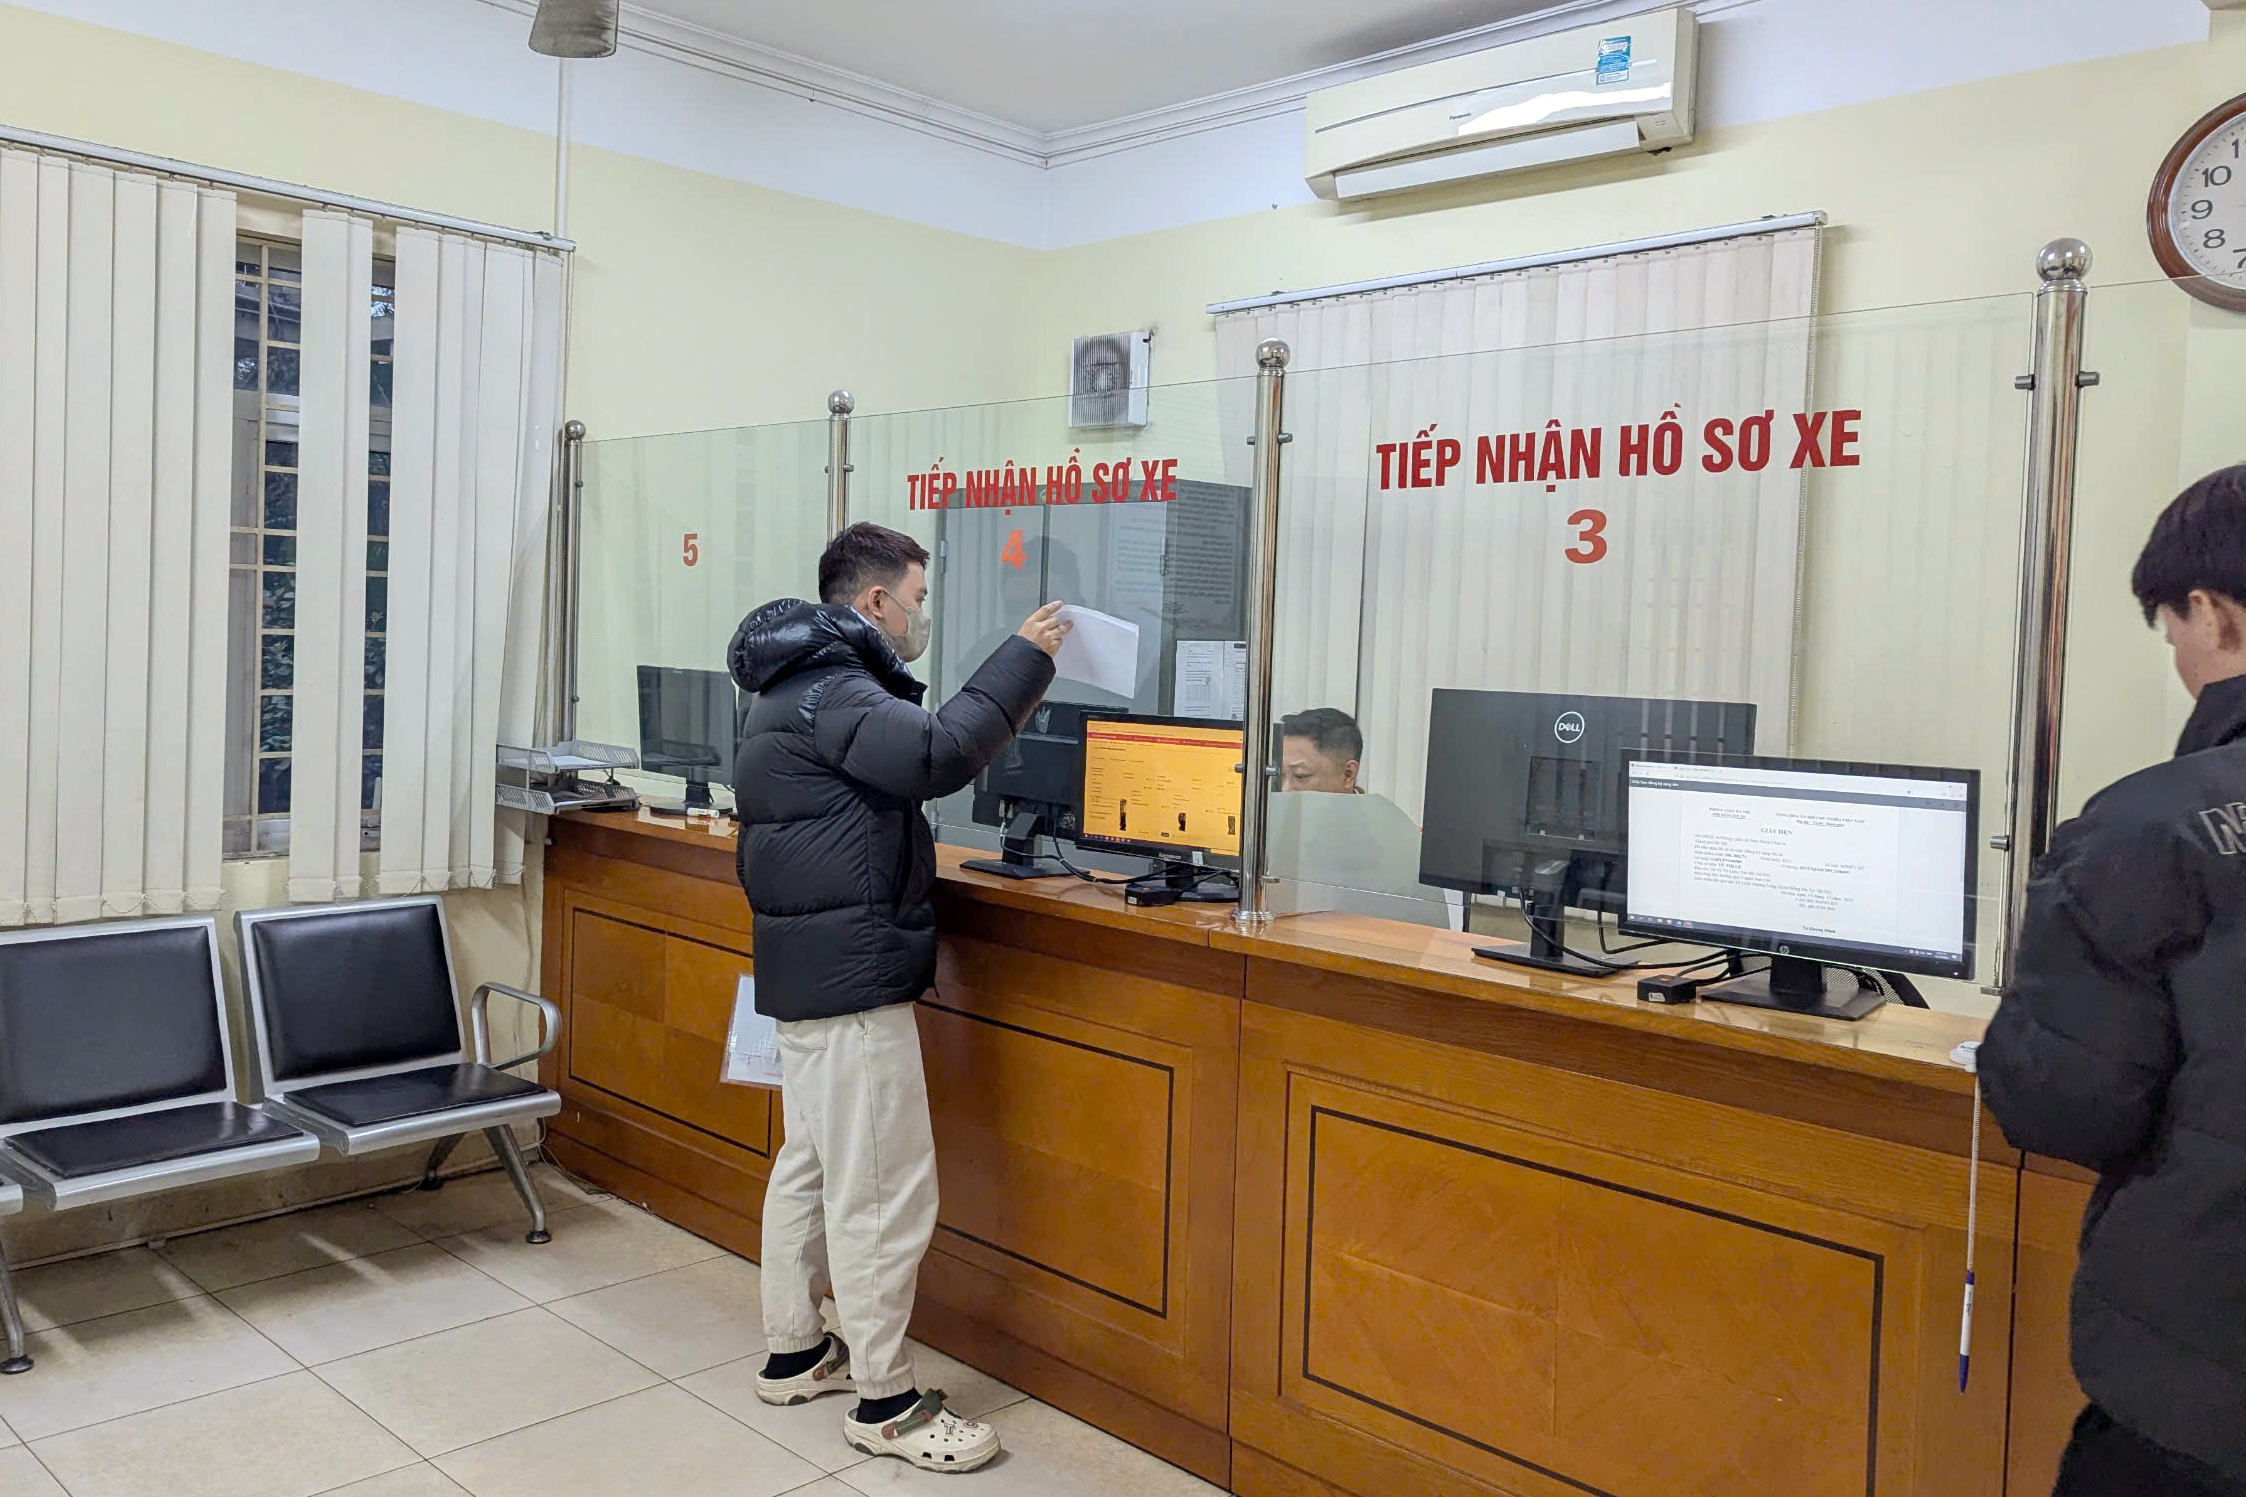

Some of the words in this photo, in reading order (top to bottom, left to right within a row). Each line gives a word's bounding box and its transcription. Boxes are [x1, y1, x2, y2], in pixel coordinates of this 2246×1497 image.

[2231, 138, 2246, 160] 1
[2202, 165, 2232, 188] 10
[2190, 199, 2213, 220] 9
[2203, 228, 2226, 249] 8
[1376, 423, 1461, 490] TIẾP
[1476, 418, 1602, 493] NHẬN
[1618, 401, 1684, 477] HỒ
[1701, 409, 1775, 473] SƠ
[1789, 409, 1862, 469] XE
[907, 456, 957, 510] TIẾP
[965, 459, 1037, 516] NHẬN
[1045, 447, 1082, 505] HỒ
[1091, 457, 1132, 504] SƠ
[1140, 458, 1178, 502] XE
[682, 533, 699, 567] 5
[1001, 529, 1027, 570] 4
[1565, 509, 1607, 564] 3
[1558, 722, 1581, 732] DELL
